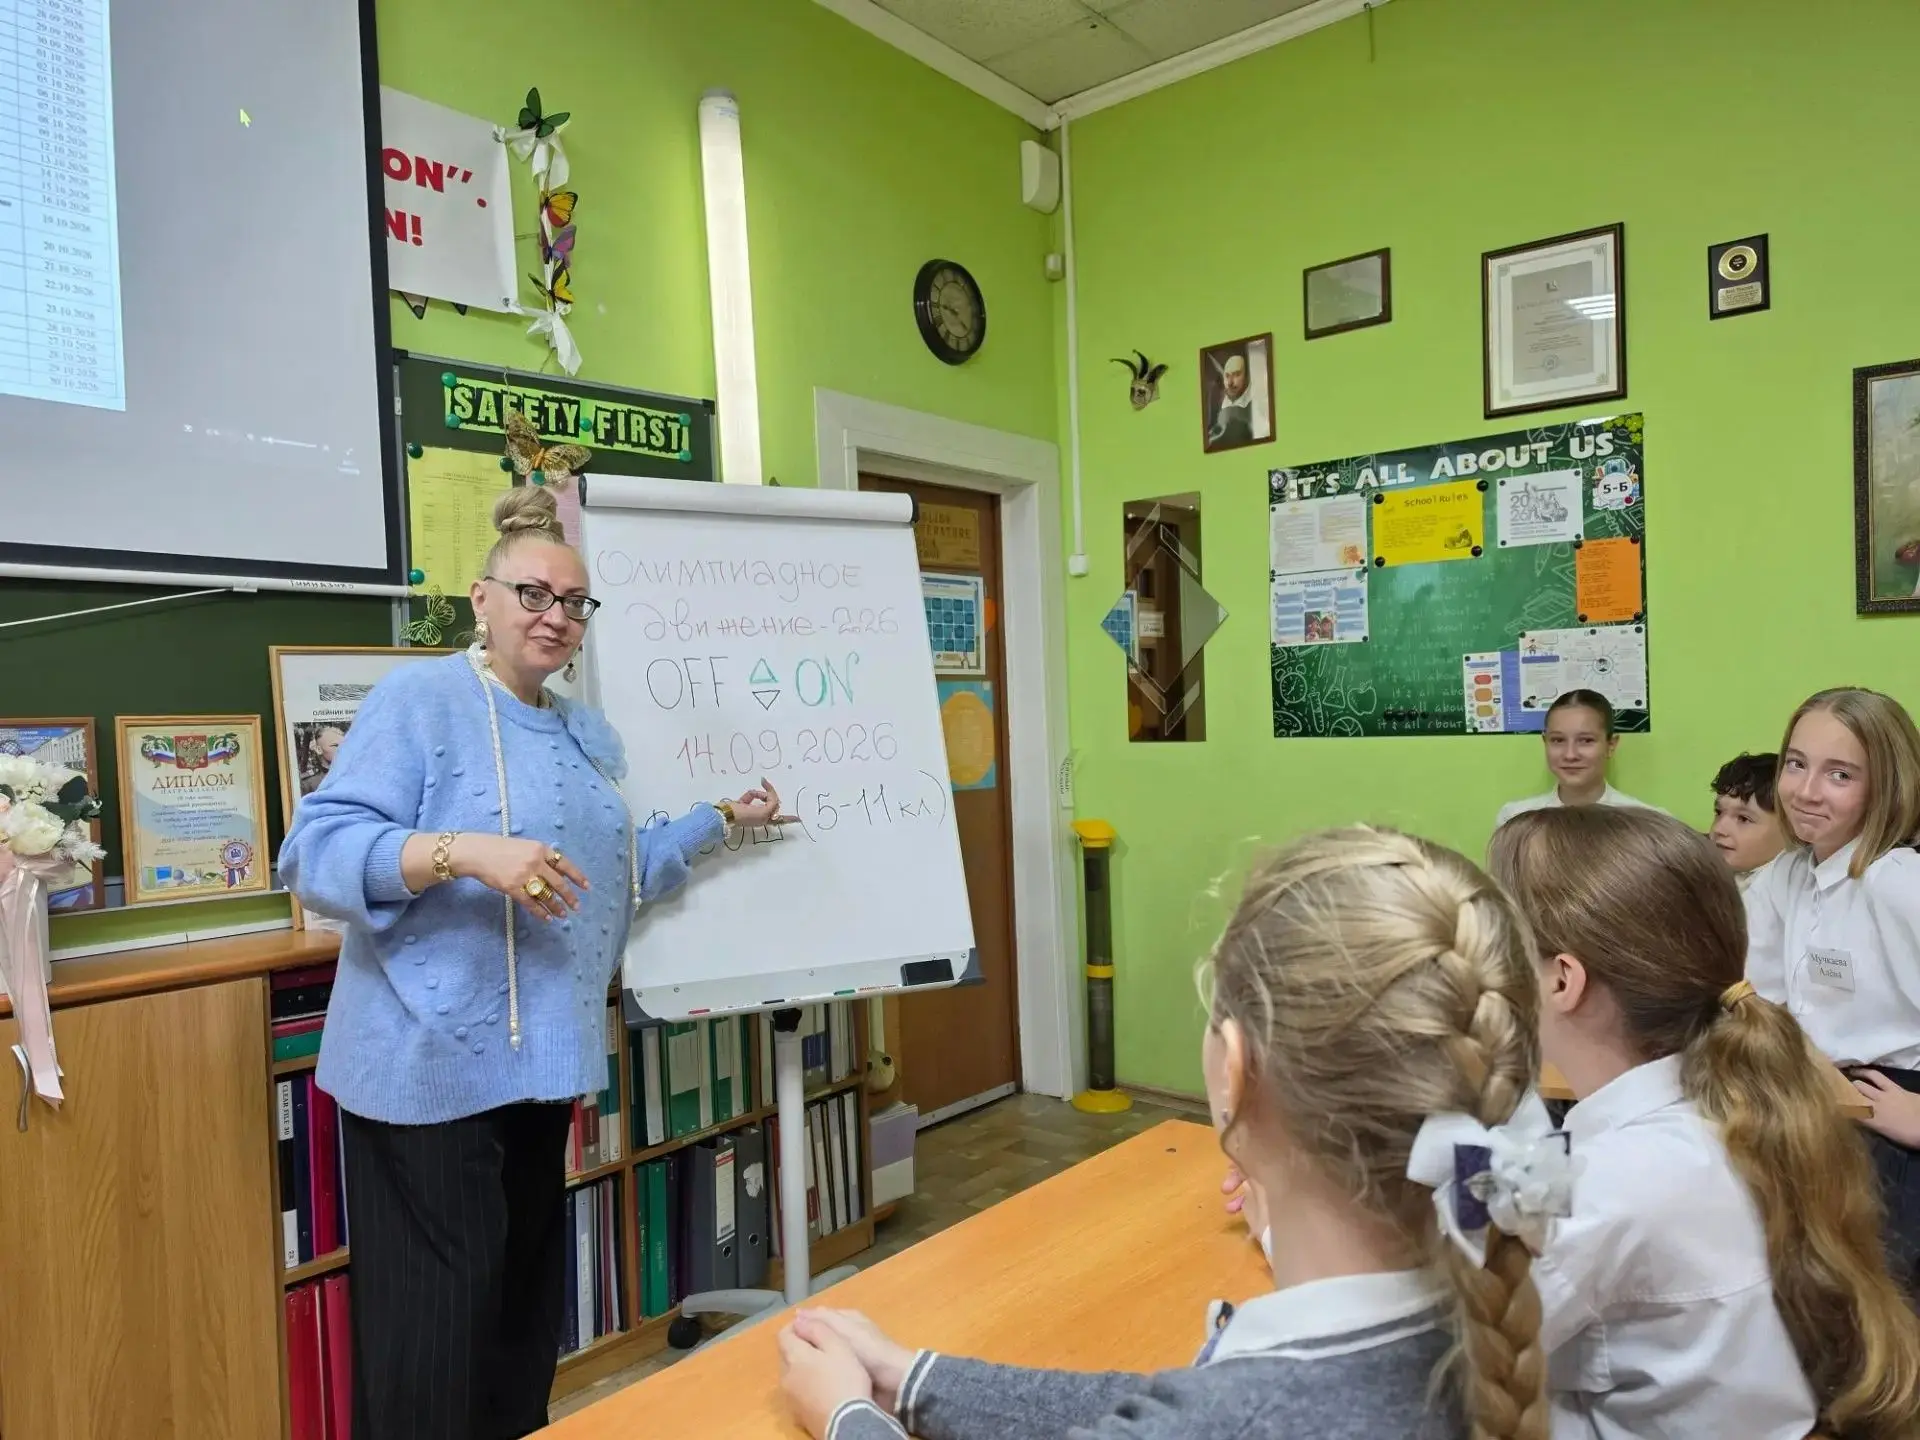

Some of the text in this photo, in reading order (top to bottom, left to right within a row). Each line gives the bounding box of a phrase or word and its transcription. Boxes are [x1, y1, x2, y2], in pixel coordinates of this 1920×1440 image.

[454, 386, 578, 434] SAFETY
[1354, 463, 1415, 490] ALL
[1429, 441, 1554, 479] ABOUT
[1569, 432, 1614, 459] US
[646, 651, 860, 710] OFF ON
[1435, 700, 1465, 712] abou
[677, 721, 898, 779] 14.09.2026
[152, 773, 234, 791] ДИПЛОМ
